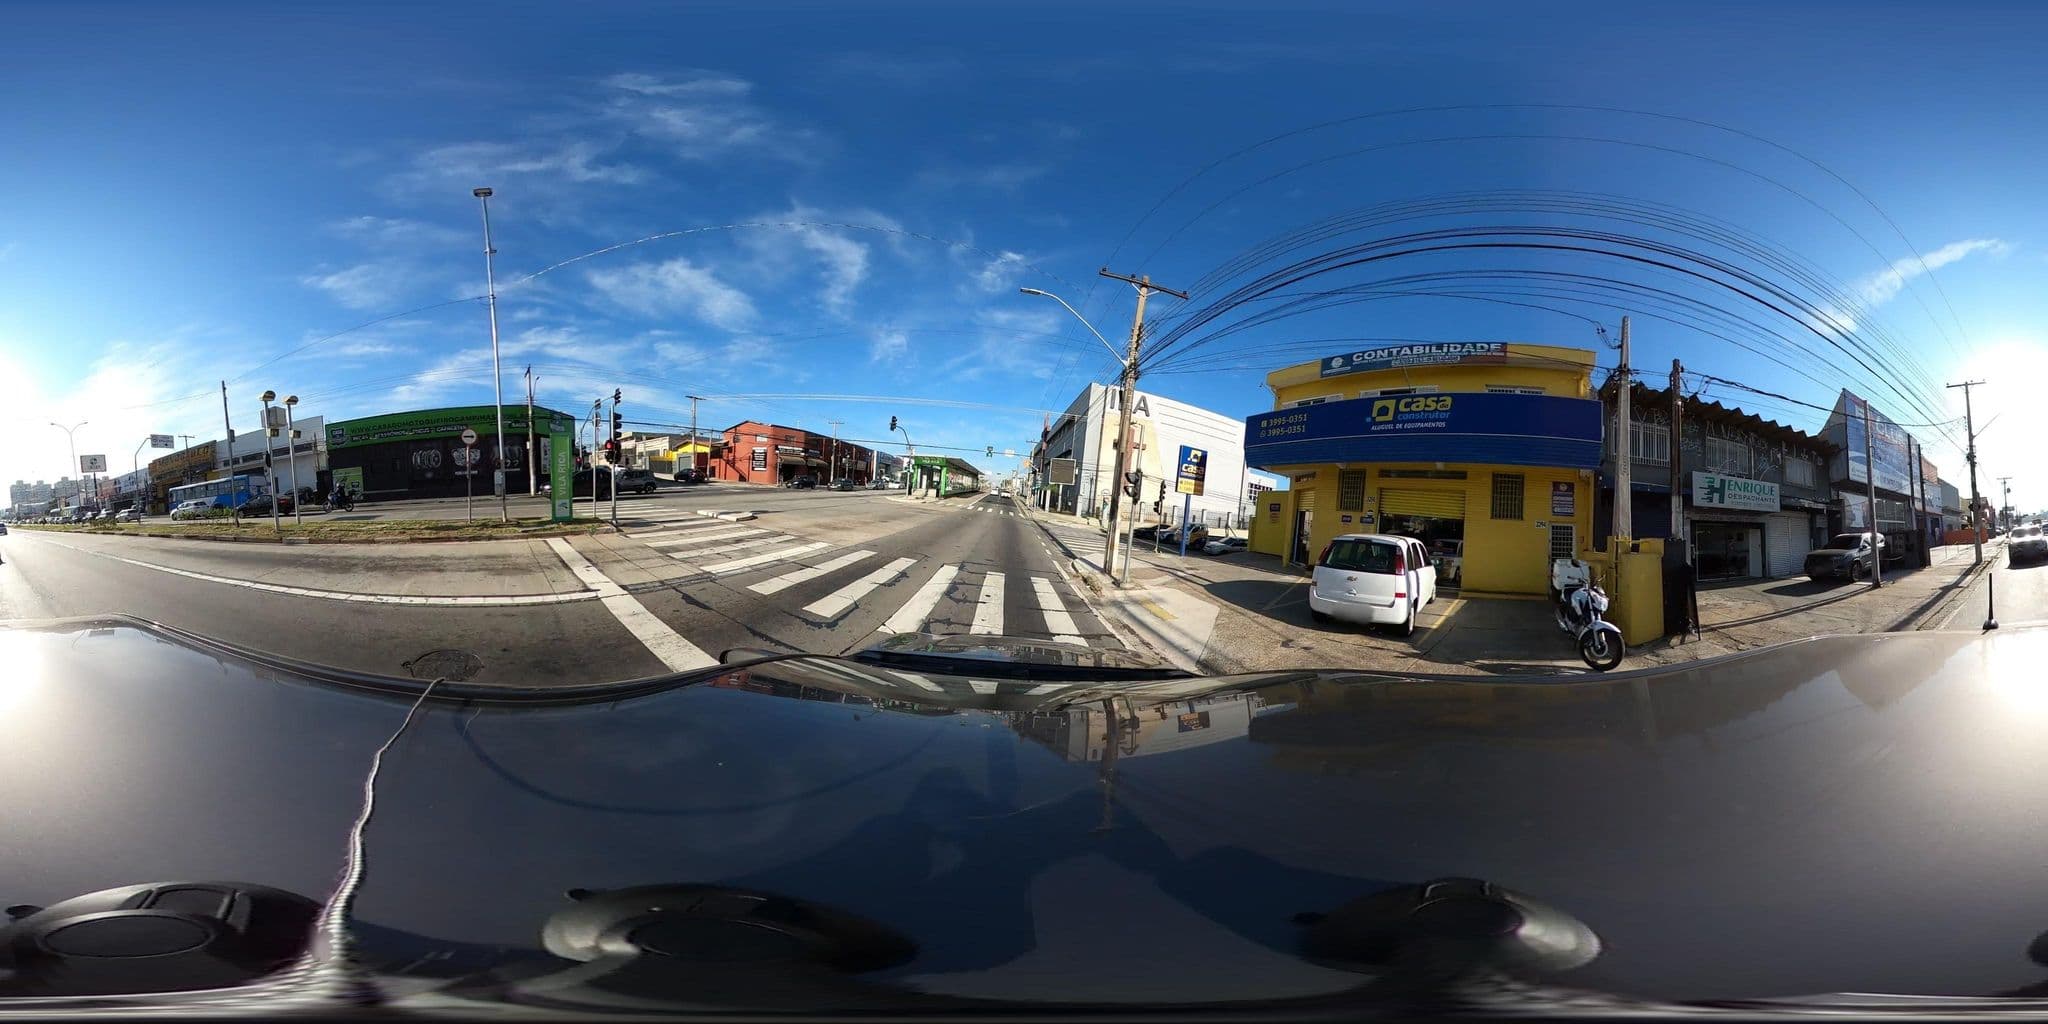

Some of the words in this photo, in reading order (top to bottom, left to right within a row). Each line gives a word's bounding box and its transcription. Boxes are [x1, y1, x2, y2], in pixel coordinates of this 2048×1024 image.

[1269, 413, 1308, 427] 3995-0351
[1397, 411, 1451, 421] construtor
[1267, 424, 1306, 437] 3995-0351
[1371, 423, 1394, 431] ALUGUEL
[1403, 421, 1446, 430] EQUIPAMENTOS
[558, 451, 567, 473] RICA
[558, 475, 567, 497] VILA
